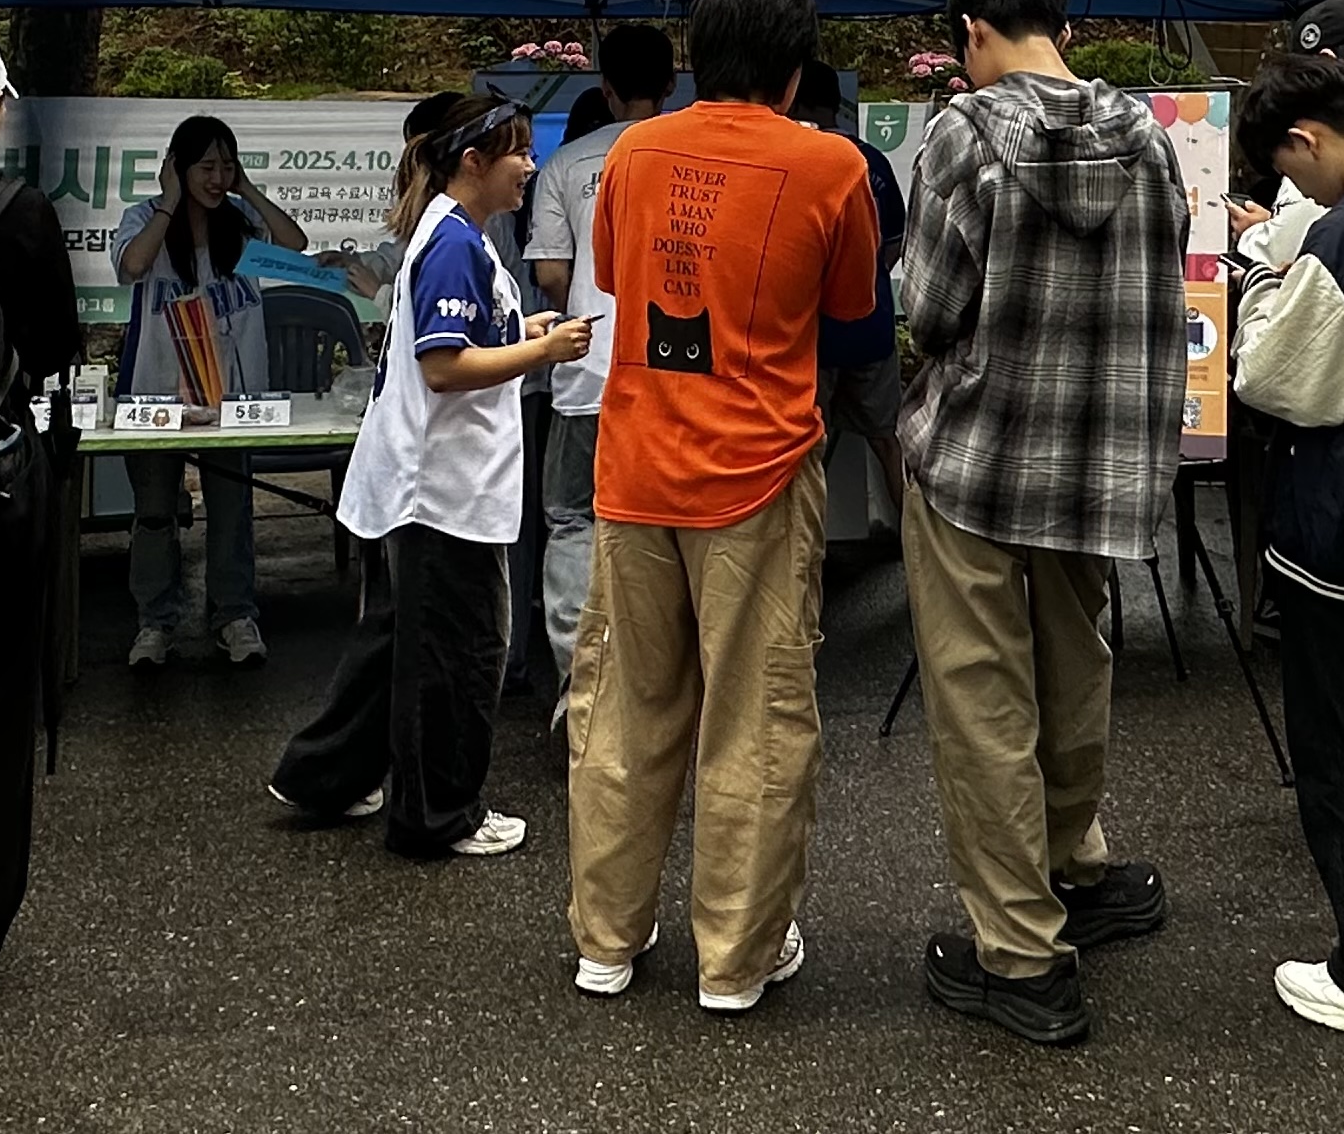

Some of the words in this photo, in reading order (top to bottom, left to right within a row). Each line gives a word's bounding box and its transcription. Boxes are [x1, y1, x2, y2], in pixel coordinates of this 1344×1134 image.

[278, 149, 396, 171] 2025.4.10.
[671, 165, 727, 187] NEVER
[277, 186, 303, 200] 창업
[307, 187, 331, 200] 교육
[336, 186, 373, 200] 수료시
[670, 183, 723, 204] TRUST
[666, 201, 677, 216] A
[679, 204, 717, 221] MAN
[670, 218, 706, 238] WHO
[652, 238, 717, 261] DOESN'T
[665, 259, 700, 277] LIKE
[663, 279, 701, 297] CATS
